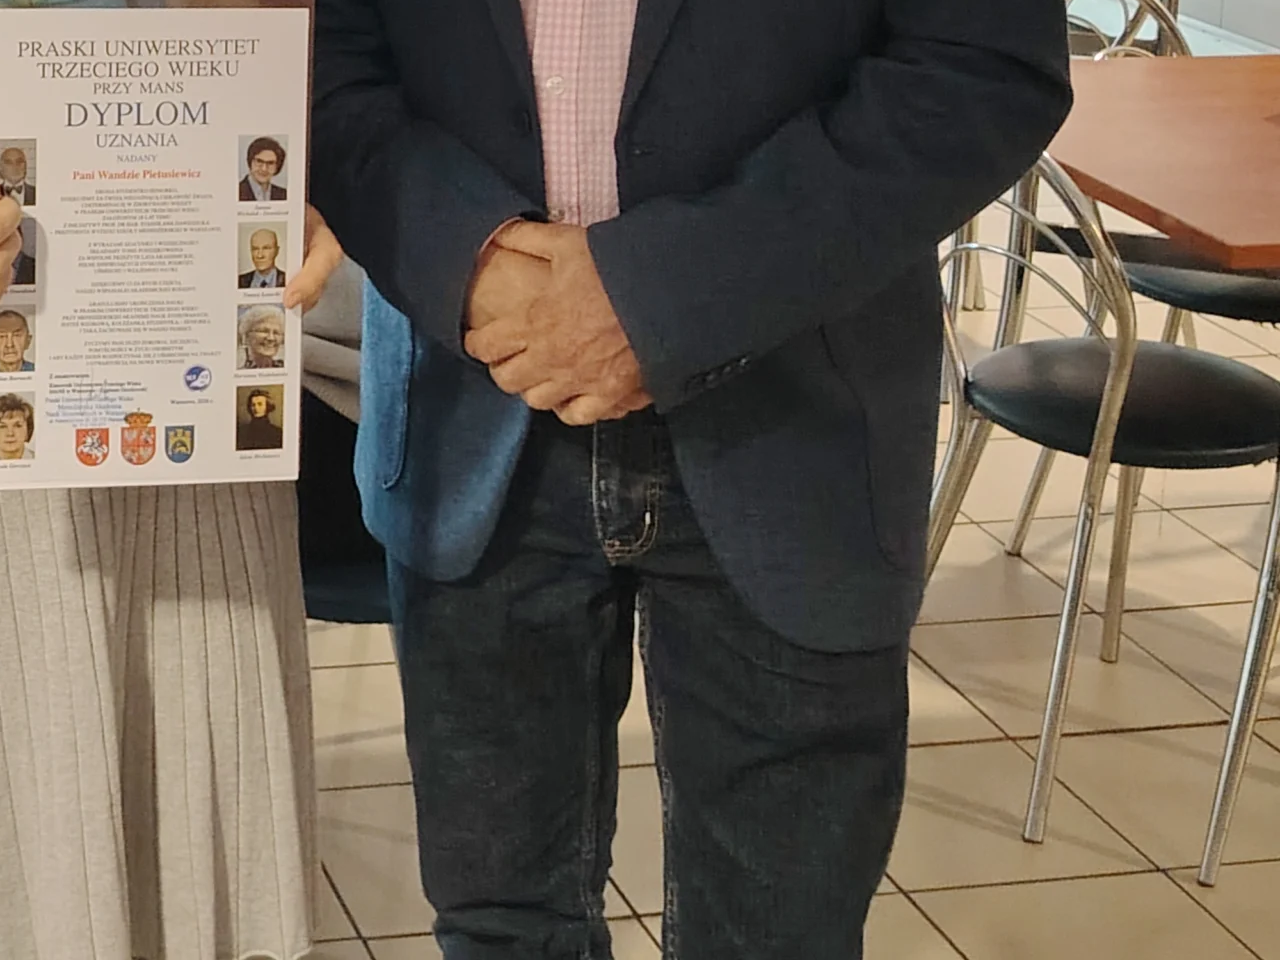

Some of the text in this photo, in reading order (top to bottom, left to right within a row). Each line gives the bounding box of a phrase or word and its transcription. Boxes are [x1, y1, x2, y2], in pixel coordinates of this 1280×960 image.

[17, 38, 260, 58] PRASKI UNIWERSYTET
[36, 60, 240, 79] TRZECIEGO WIEKU
[93, 81, 184, 95] PRZY MANS
[64, 100, 209, 127] DYPLOM
[95, 133, 179, 148] UZNANIA
[116, 154, 157, 164] NADANY
[72, 170, 95, 180] Pani
[98, 170, 140, 180] Wandzie
